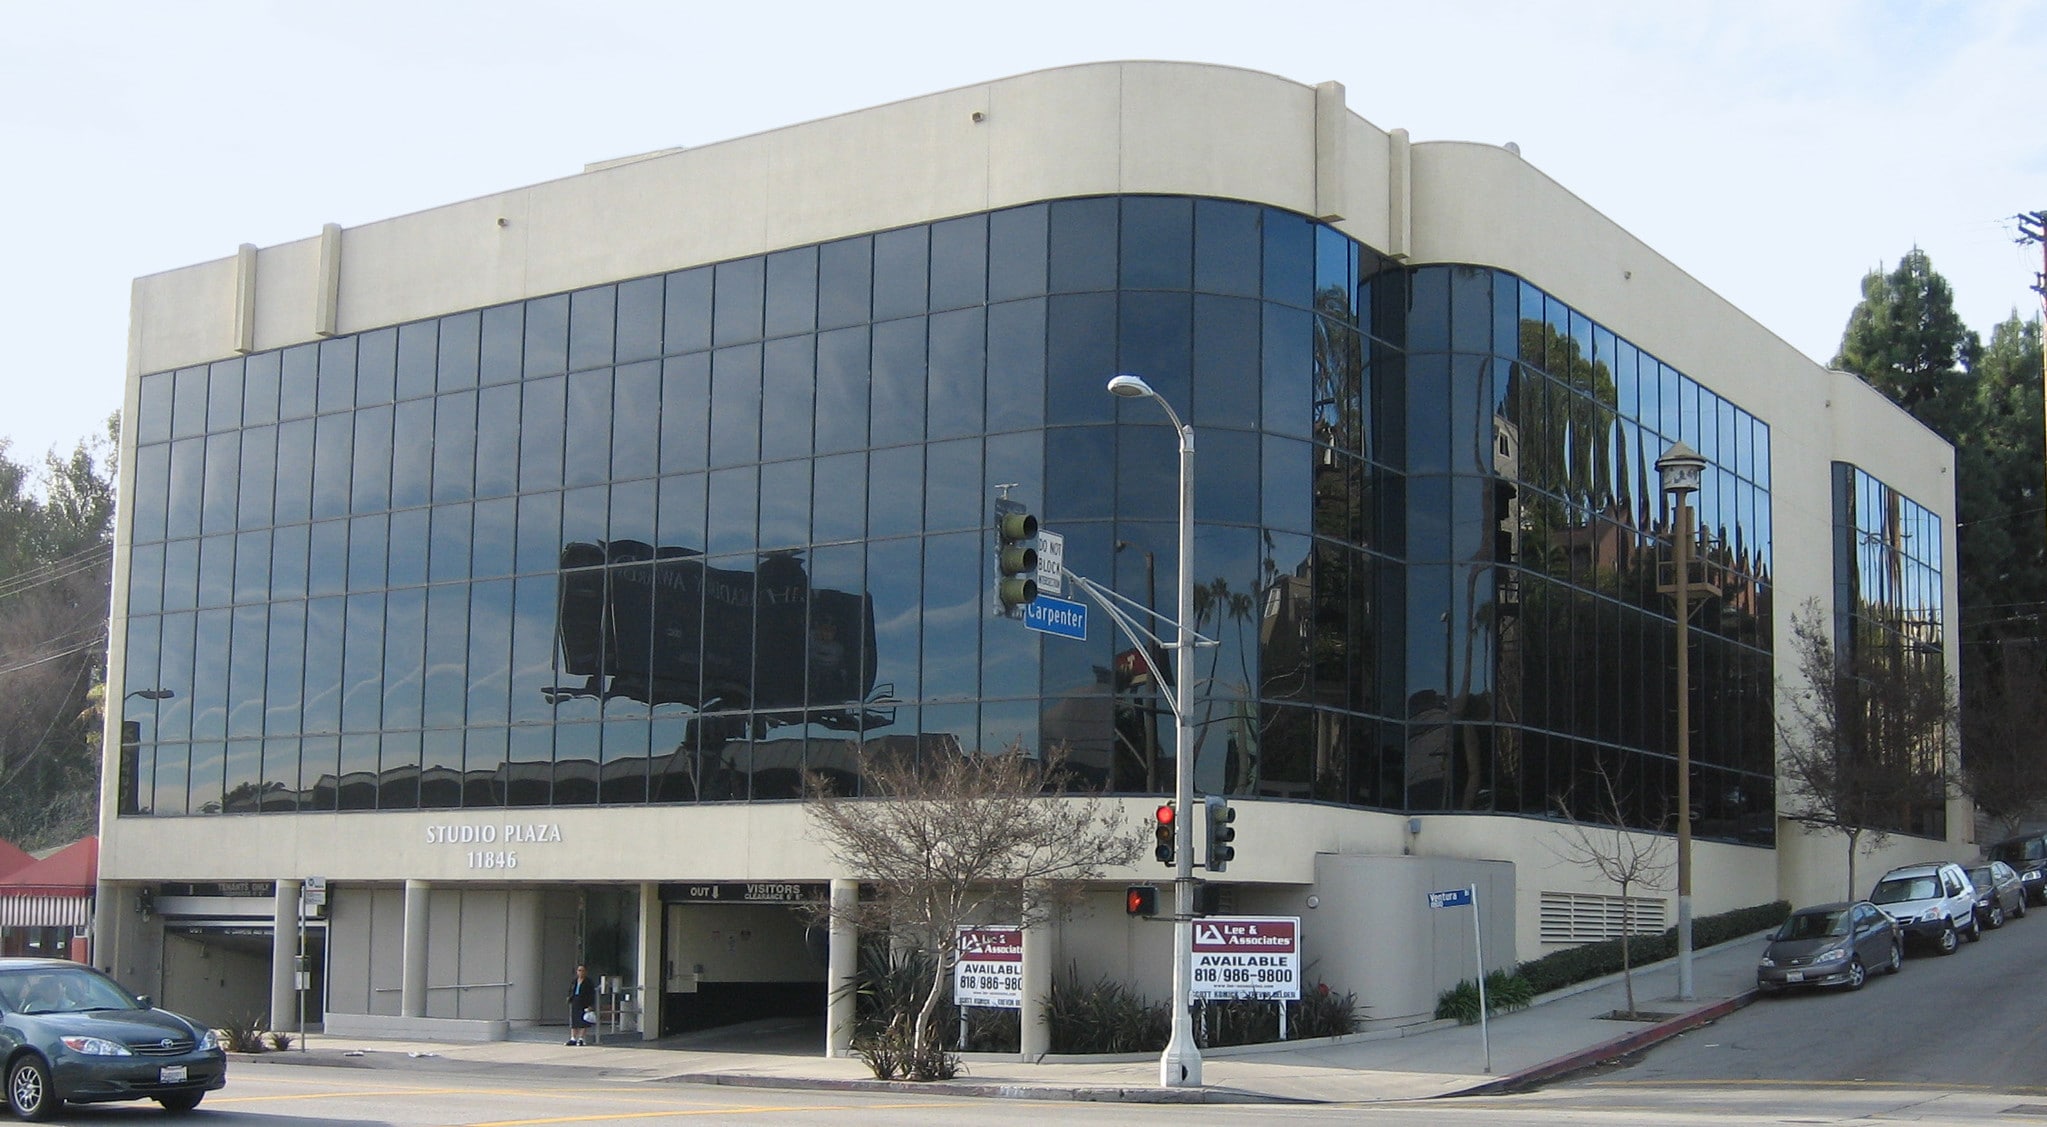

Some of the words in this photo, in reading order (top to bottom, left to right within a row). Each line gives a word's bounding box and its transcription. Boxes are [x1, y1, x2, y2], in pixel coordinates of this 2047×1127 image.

[1050, 541, 1061, 556] NOT
[1039, 557, 1062, 575] BLOCK
[1028, 601, 1083, 627] Carpenter
[426, 825, 497, 843] STUDIO
[505, 824, 562, 843] PLAZA
[467, 850, 517, 868] 11846
[690, 887, 709, 896] OUT
[747, 884, 800, 894] VISITORS
[1430, 893, 1457, 902] Ventura
[1224, 925, 1245, 934] Lee
[1249, 925, 1257, 934] &
[1228, 935, 1290, 945] Associates
[984, 944, 1023, 953] Associat
[1200, 956, 1287, 966] AVAILABLE
[964, 964, 1022, 975] AVAILABL
[1194, 968, 1292, 982] 818/986-9800
[960, 975, 1022, 991] 818/986-980
